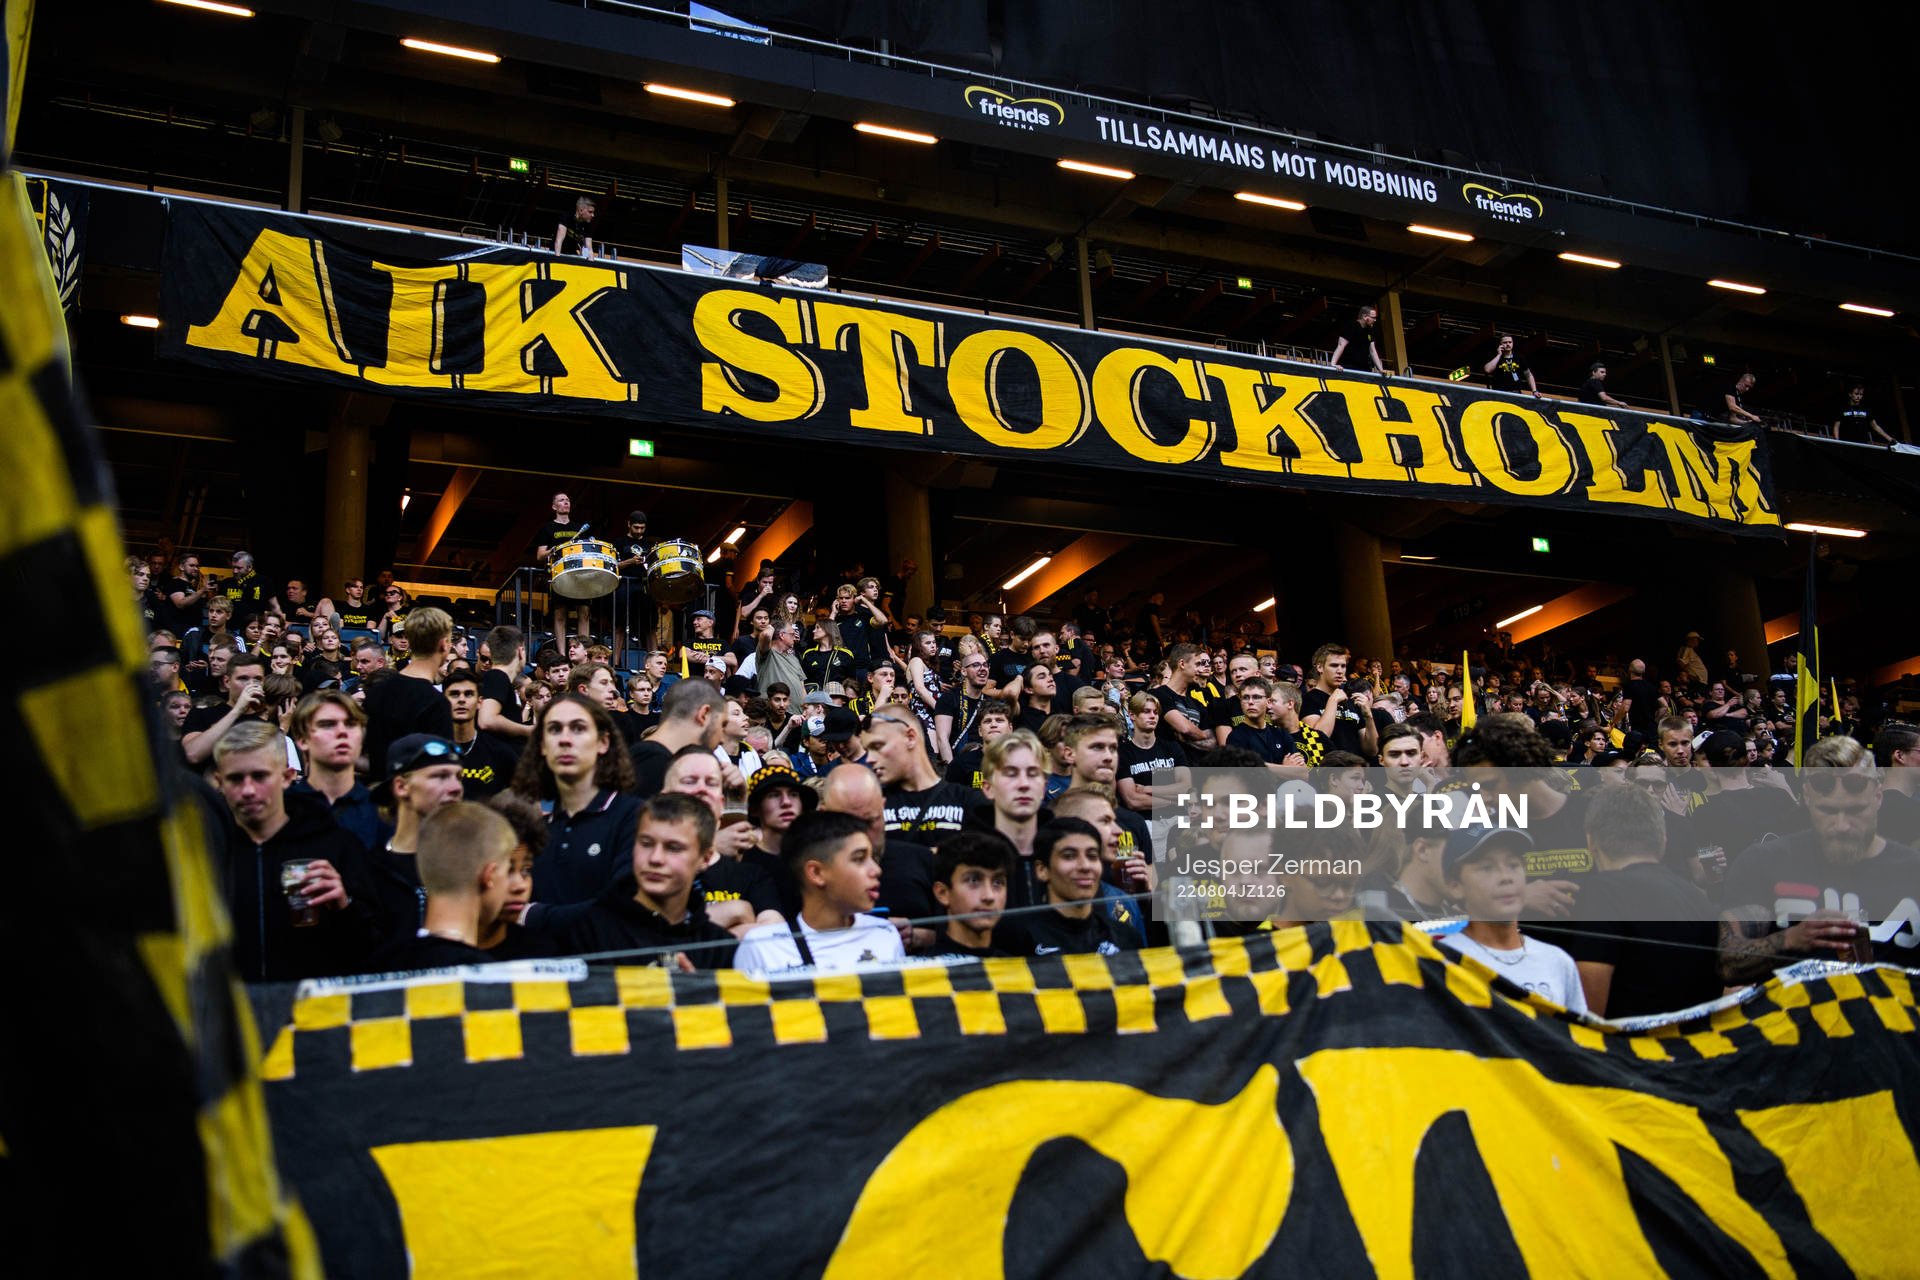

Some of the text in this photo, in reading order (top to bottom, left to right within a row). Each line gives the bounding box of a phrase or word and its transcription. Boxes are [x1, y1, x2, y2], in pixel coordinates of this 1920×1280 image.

[980, 97, 1050, 126] friends
[999, 120, 1034, 131] ARENA
[1095, 116, 1438, 204] TILLSAMMANS MOT MOBBNING
[1475, 193, 1533, 219] friends
[186, 228, 1782, 525] AIK STOCKHOLM
